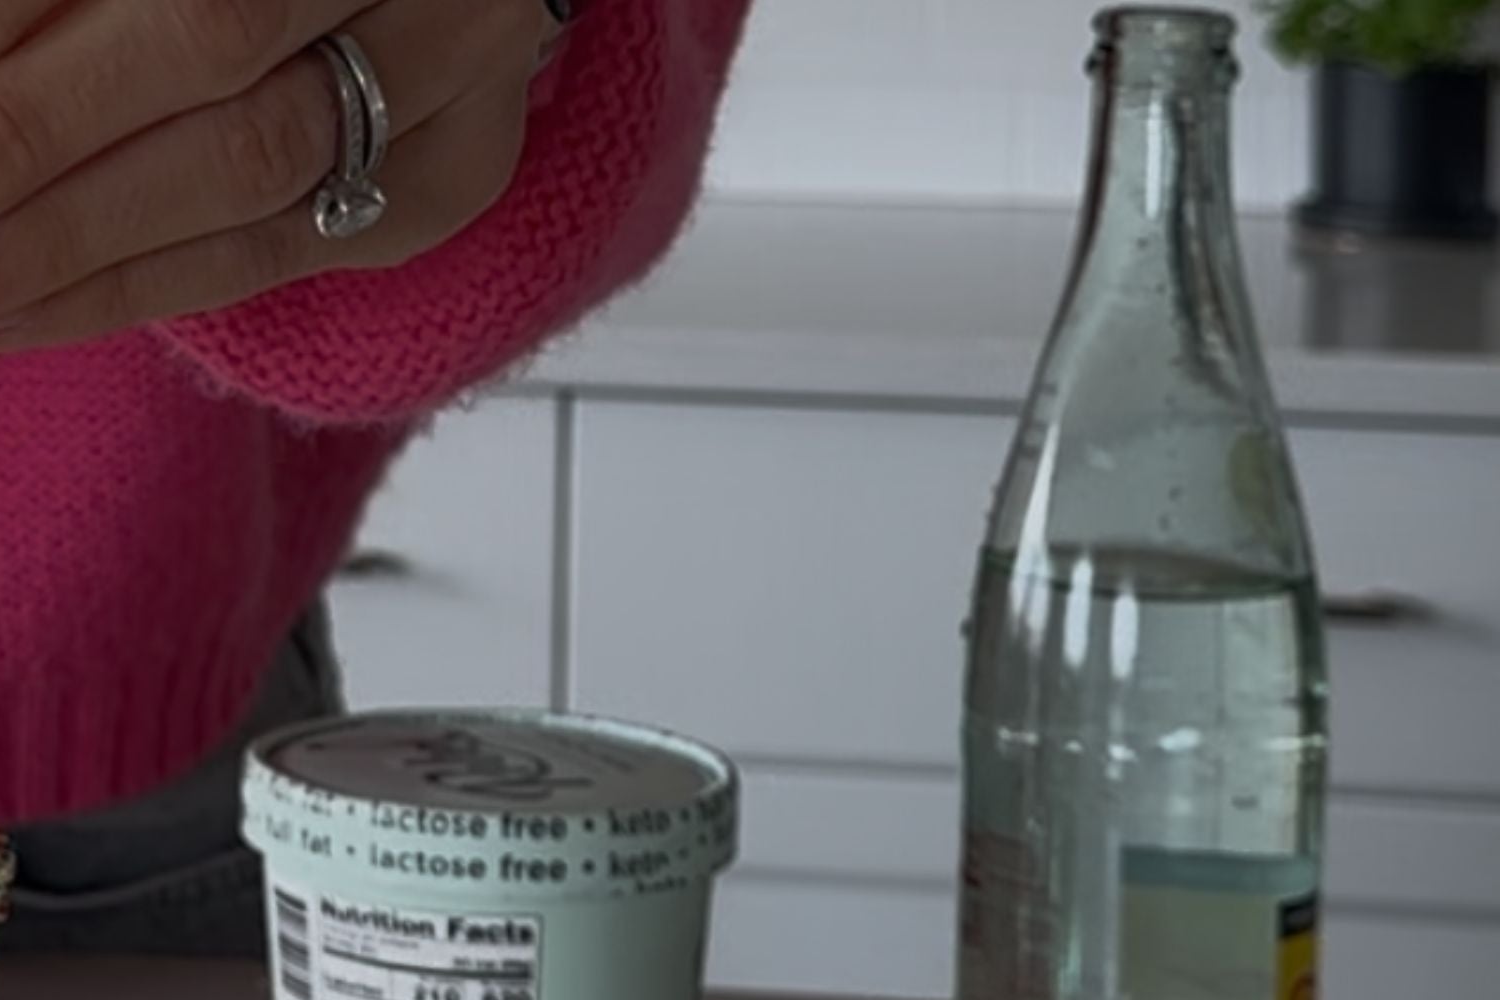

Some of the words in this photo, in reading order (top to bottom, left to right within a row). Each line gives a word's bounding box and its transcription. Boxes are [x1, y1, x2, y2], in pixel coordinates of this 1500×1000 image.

[370, 800, 488, 839] lactose
[502, 811, 568, 841] free
[370, 842, 488, 880] lactose
[502, 852, 568, 883] free
[320, 897, 436, 939] Nutrition
[448, 916, 535, 945] Facts
